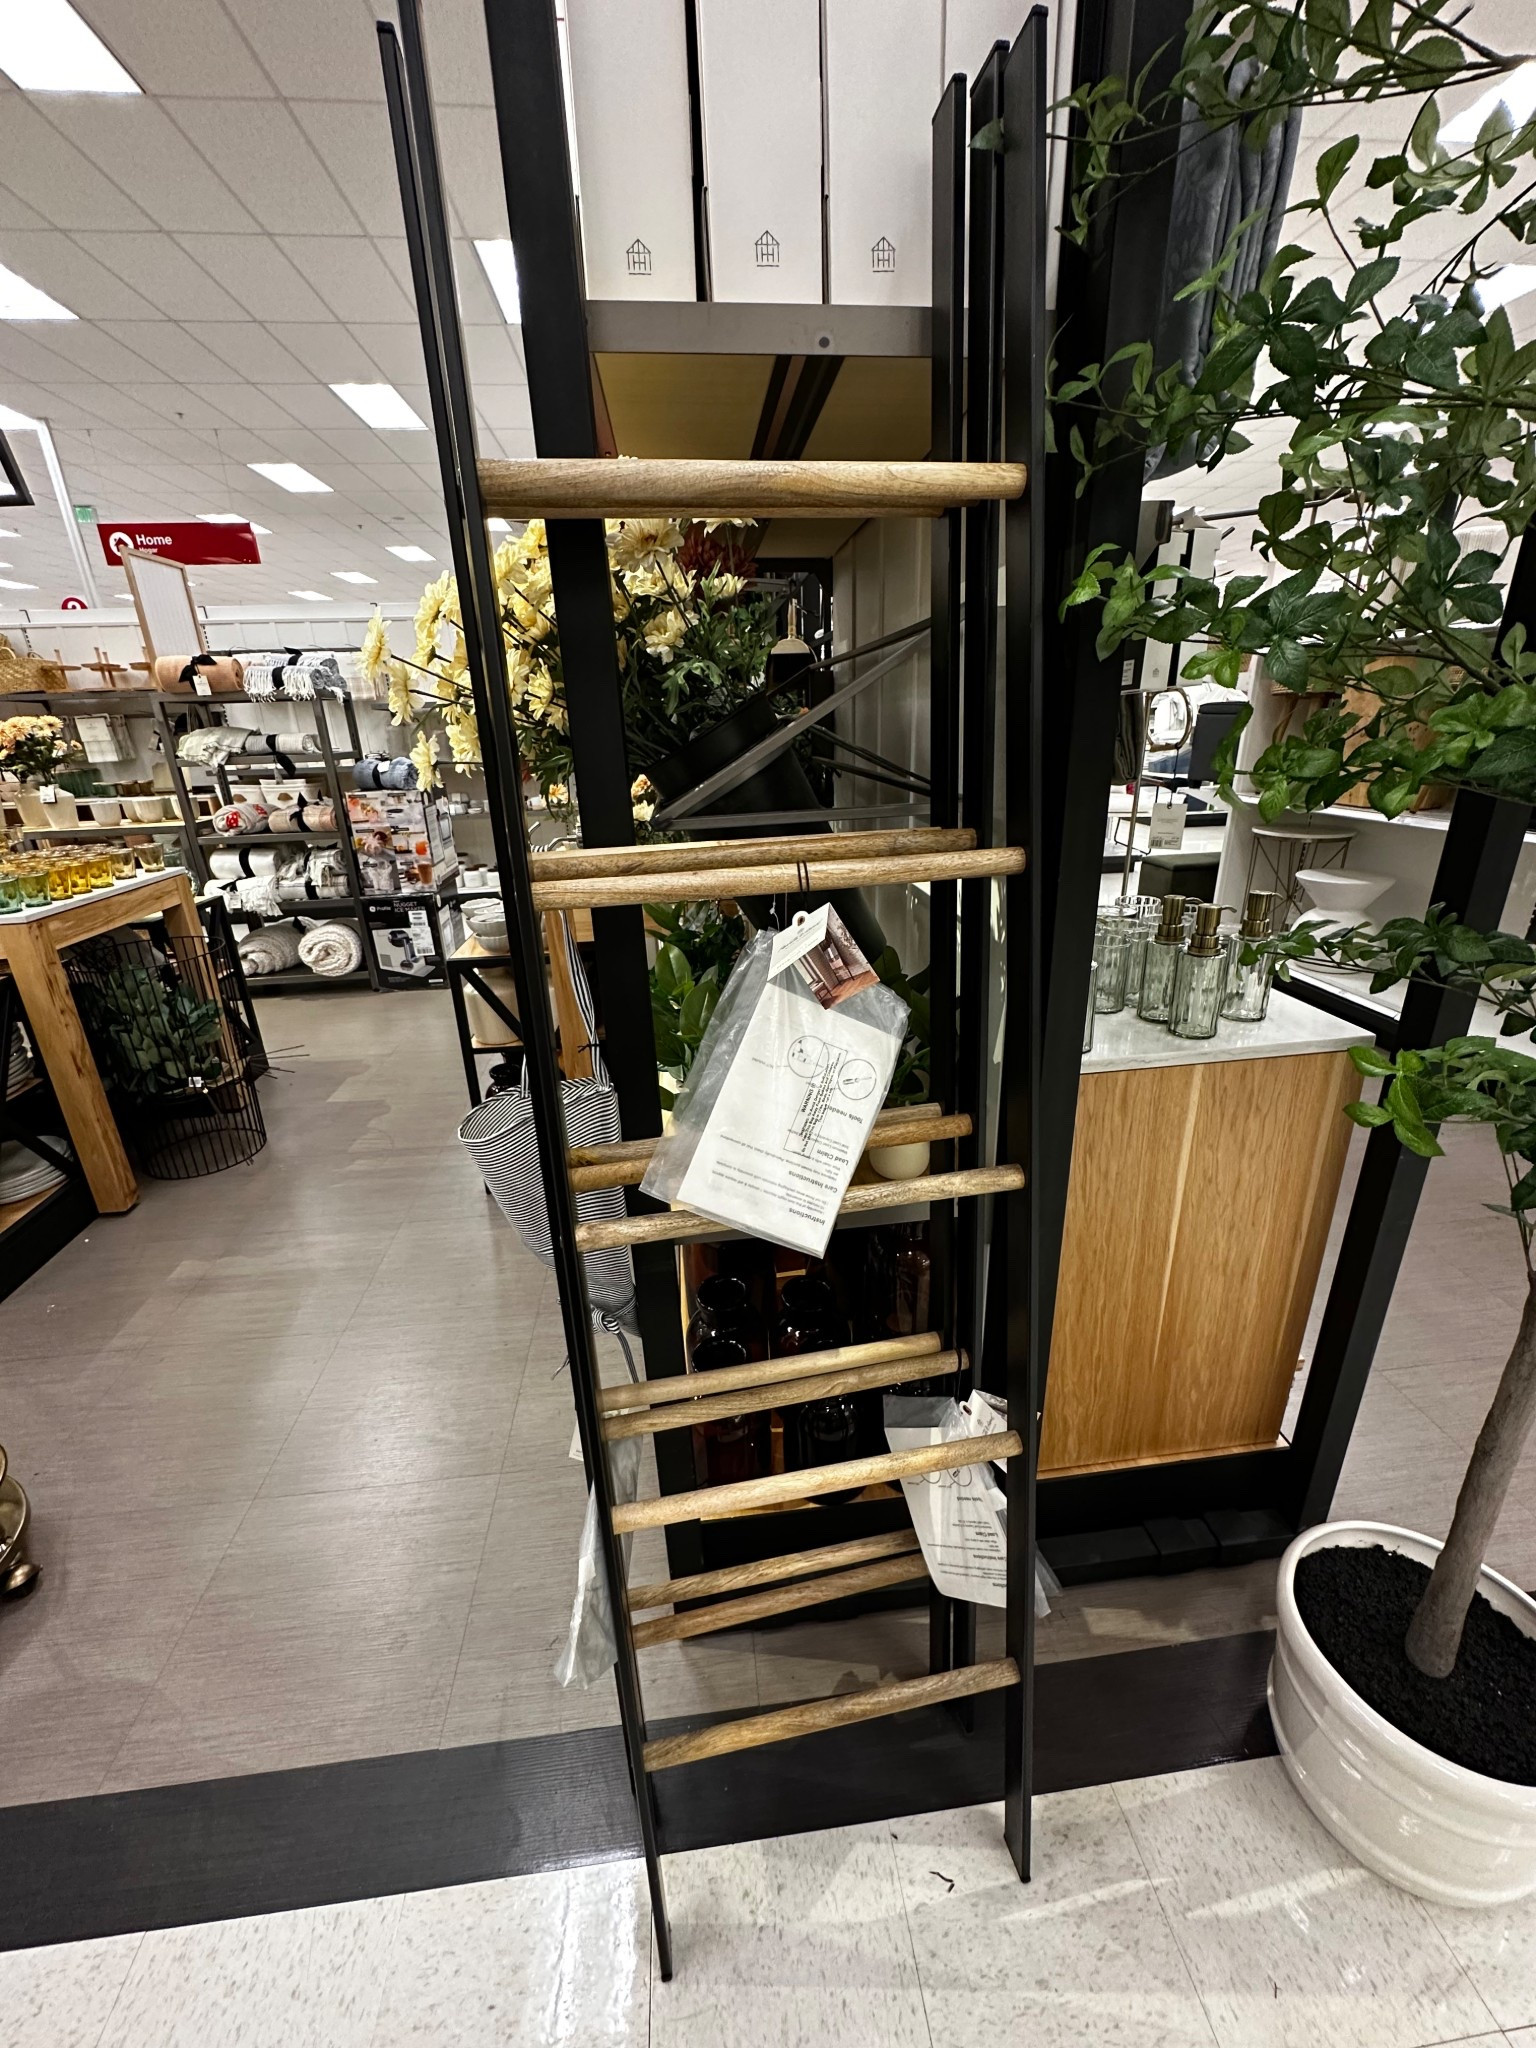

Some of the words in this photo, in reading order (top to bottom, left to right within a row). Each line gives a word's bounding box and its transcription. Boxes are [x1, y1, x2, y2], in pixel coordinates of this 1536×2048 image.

[135, 534, 172, 545] Home
[801, 1089, 813, 1112] WARNING
[847, 1113, 863, 1124] Tools
[816, 1149, 834, 1160] Claim
[834, 1156, 848, 1165] Load
[787, 1170, 823, 1188] Instructions
[823, 1184, 838, 1193] Care
[787, 1206, 825, 1225] Instructions
